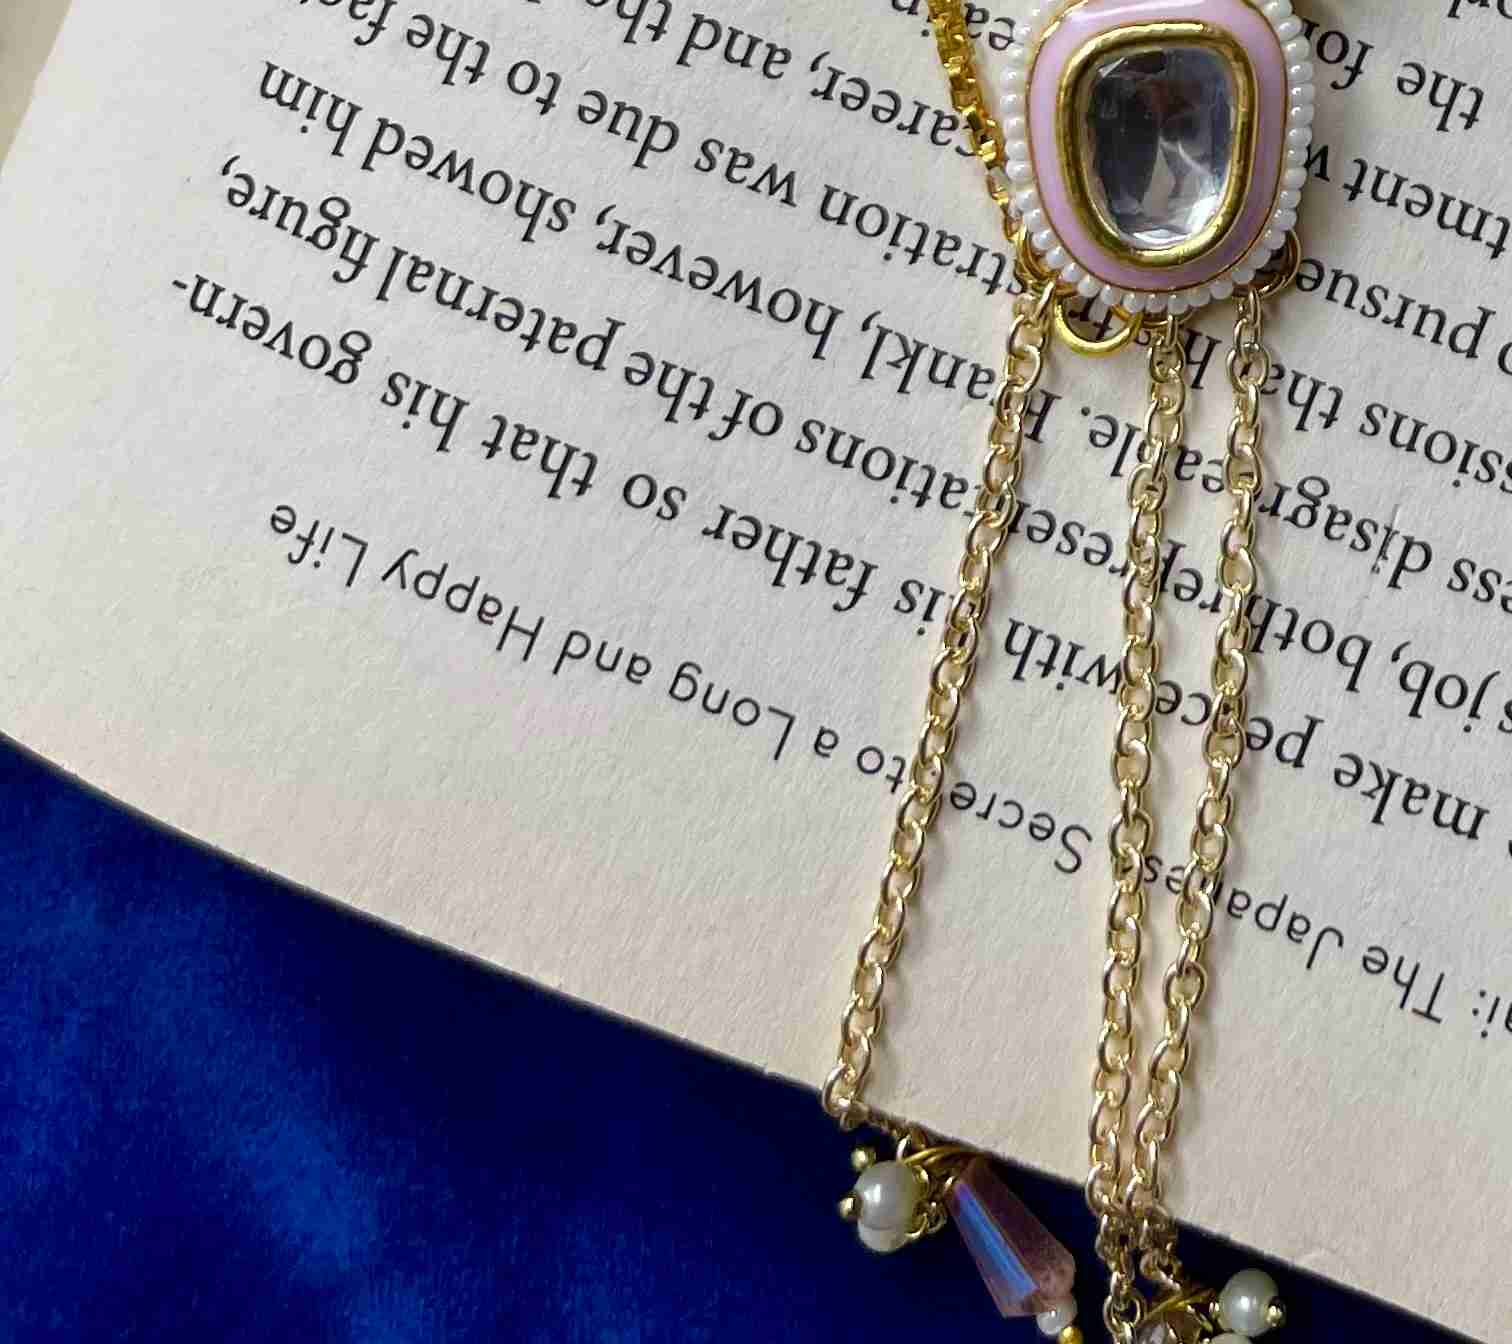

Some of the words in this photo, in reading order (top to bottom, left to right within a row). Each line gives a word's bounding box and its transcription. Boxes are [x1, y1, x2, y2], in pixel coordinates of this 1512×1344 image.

[258, 60, 363, 158] him
[1395, 60, 1485, 133] the
[220, 154, 381, 284] figure,
[359, 116, 577, 244] showed
[374, 244, 627, 372] paternal
[594, 203, 844, 361] however,
[171, 273, 373, 385] govern-
[379, 370, 470, 453] his
[622, 350, 715, 425] the
[706, 387, 784, 442] of
[480, 413, 598, 500] that
[620, 472, 687, 521] so
[269, 503, 369, 588] Life
[700, 503, 879, 613] father
[380, 547, 545, 662] Happy
[551, 629, 652, 685] and
[1003, 617, 1130, 695] with
[1389, 639, 1501, 734] job,
[667, 660, 796, 761] Long
[812, 724, 840, 759] a
[855, 744, 906, 795] to
[1332, 751, 1490, 841] make
[1360, 944, 1445, 1025] The
